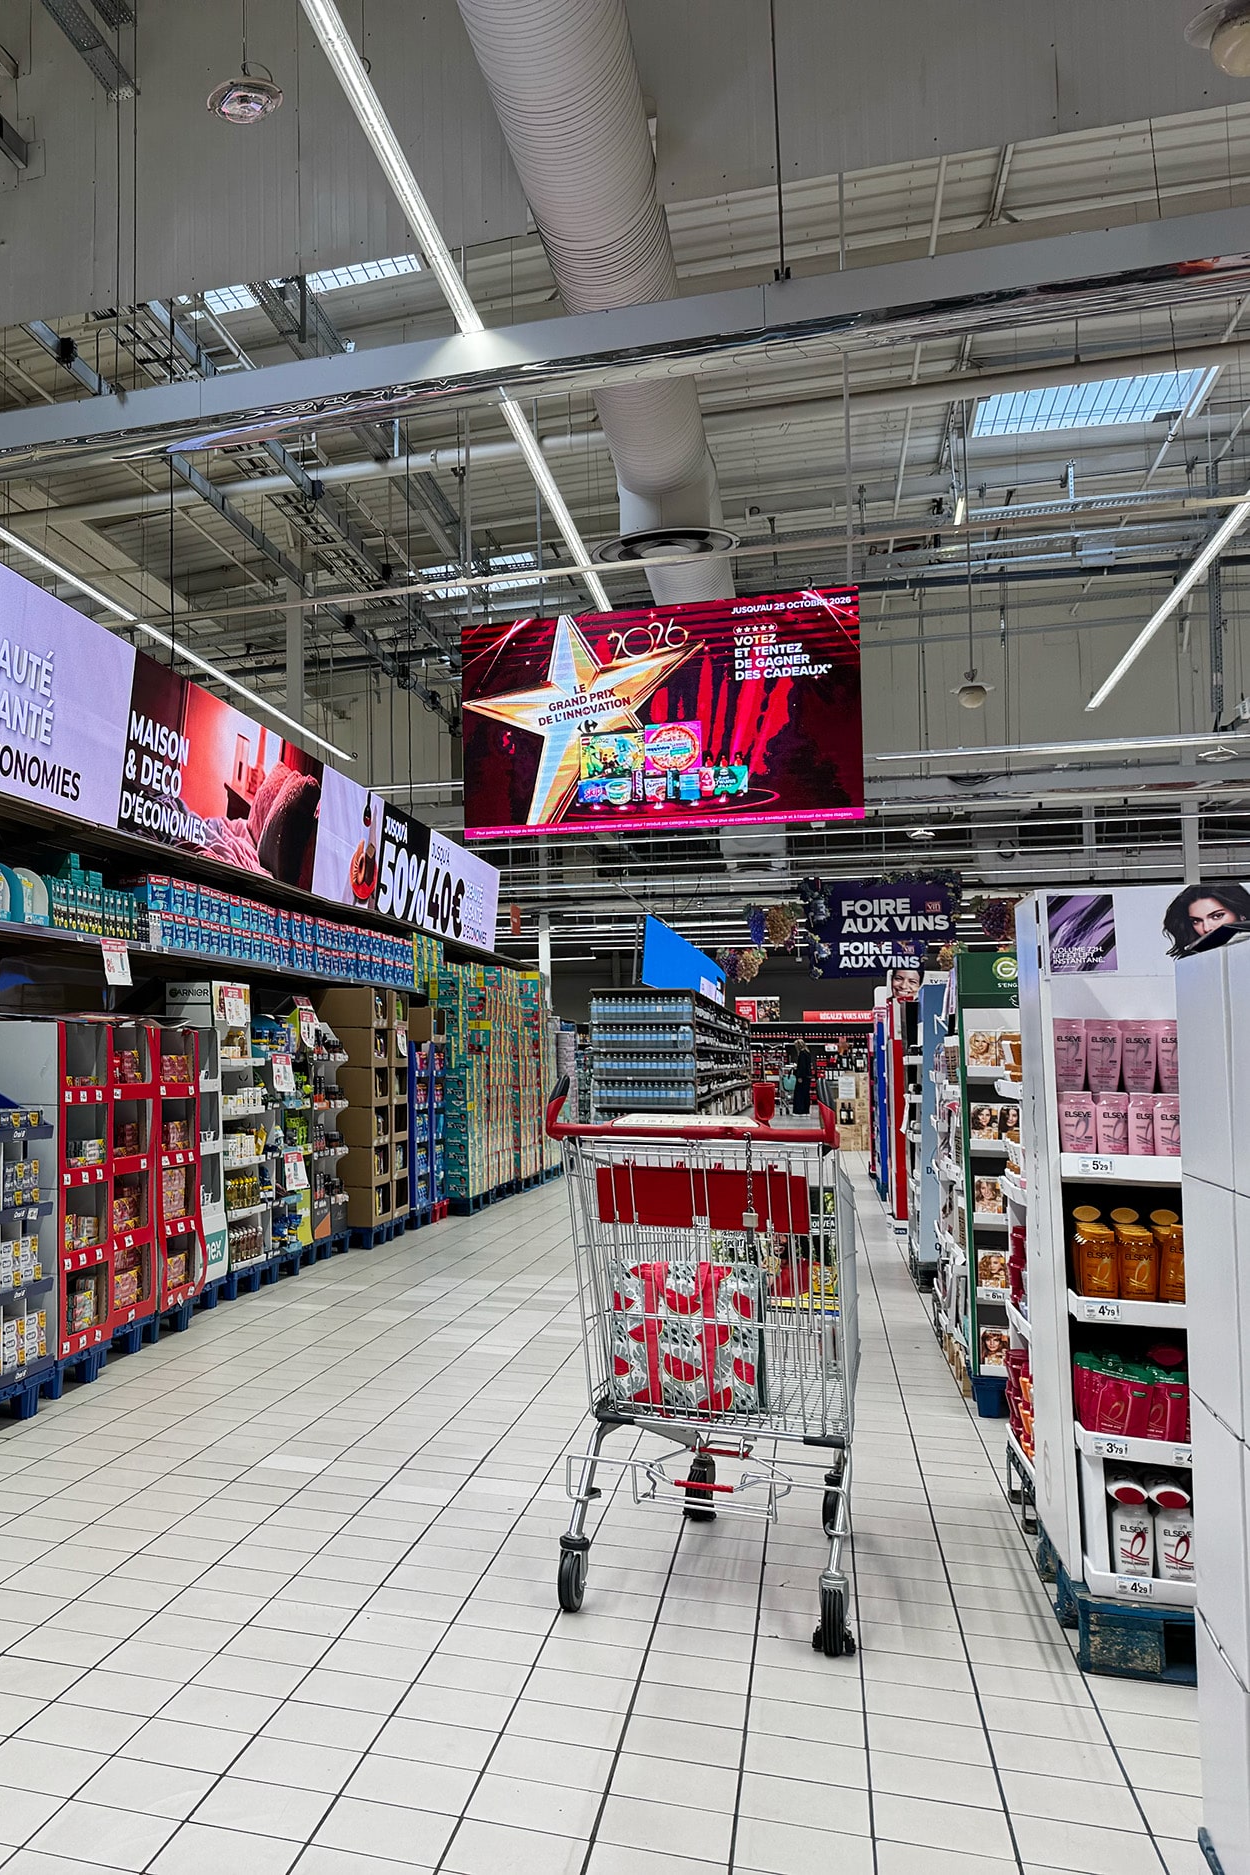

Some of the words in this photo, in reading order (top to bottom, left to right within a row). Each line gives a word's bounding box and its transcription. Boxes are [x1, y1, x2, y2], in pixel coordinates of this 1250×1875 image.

[731, 603, 772, 615] JUSQU'AU
[734, 633, 777, 646] VOTEZ
[734, 647, 750, 658] ET
[753, 643, 803, 656] TENTEZ
[735, 659, 752, 670] DE
[755, 654, 810, 668] GAGNER
[735, 670, 761, 681] DES
[573, 683, 586, 695] LE
[548, 695, 587, 712] GRAND
[589, 687, 616, 702] PRIX
[538, 715, 553, 726] DE
[130, 710, 190, 767] MAISON
[125, 749, 137, 780] &
[140, 755, 182, 798] DECO
[120, 790, 208, 846] D'ÉCONOMIES
[377, 840, 426, 926] 50%
[427, 867, 465, 938] 40€
[841, 898, 910, 917] FOIRE
[841, 917, 890, 934] AUX
[893, 914, 950, 931] VINS
[839, 941, 892, 956] FOIRE
[1052, 946, 1086, 954] VOLUME
[839, 956, 876, 968] AUX
[878, 956, 920, 968] VINS
[169, 986, 209, 998] GARNIER
[1057, 1035, 1082, 1043] ELSEVE
[1091, 1036, 1117, 1044] ELSEVE
[1125, 1037, 1151, 1045] ELSEVE
[1124, 1253, 1153, 1261] ELSEVE
[1120, 1524, 1149, 1534] ELSEVE
[1163, 1528, 1192, 1538] ELSEVE
